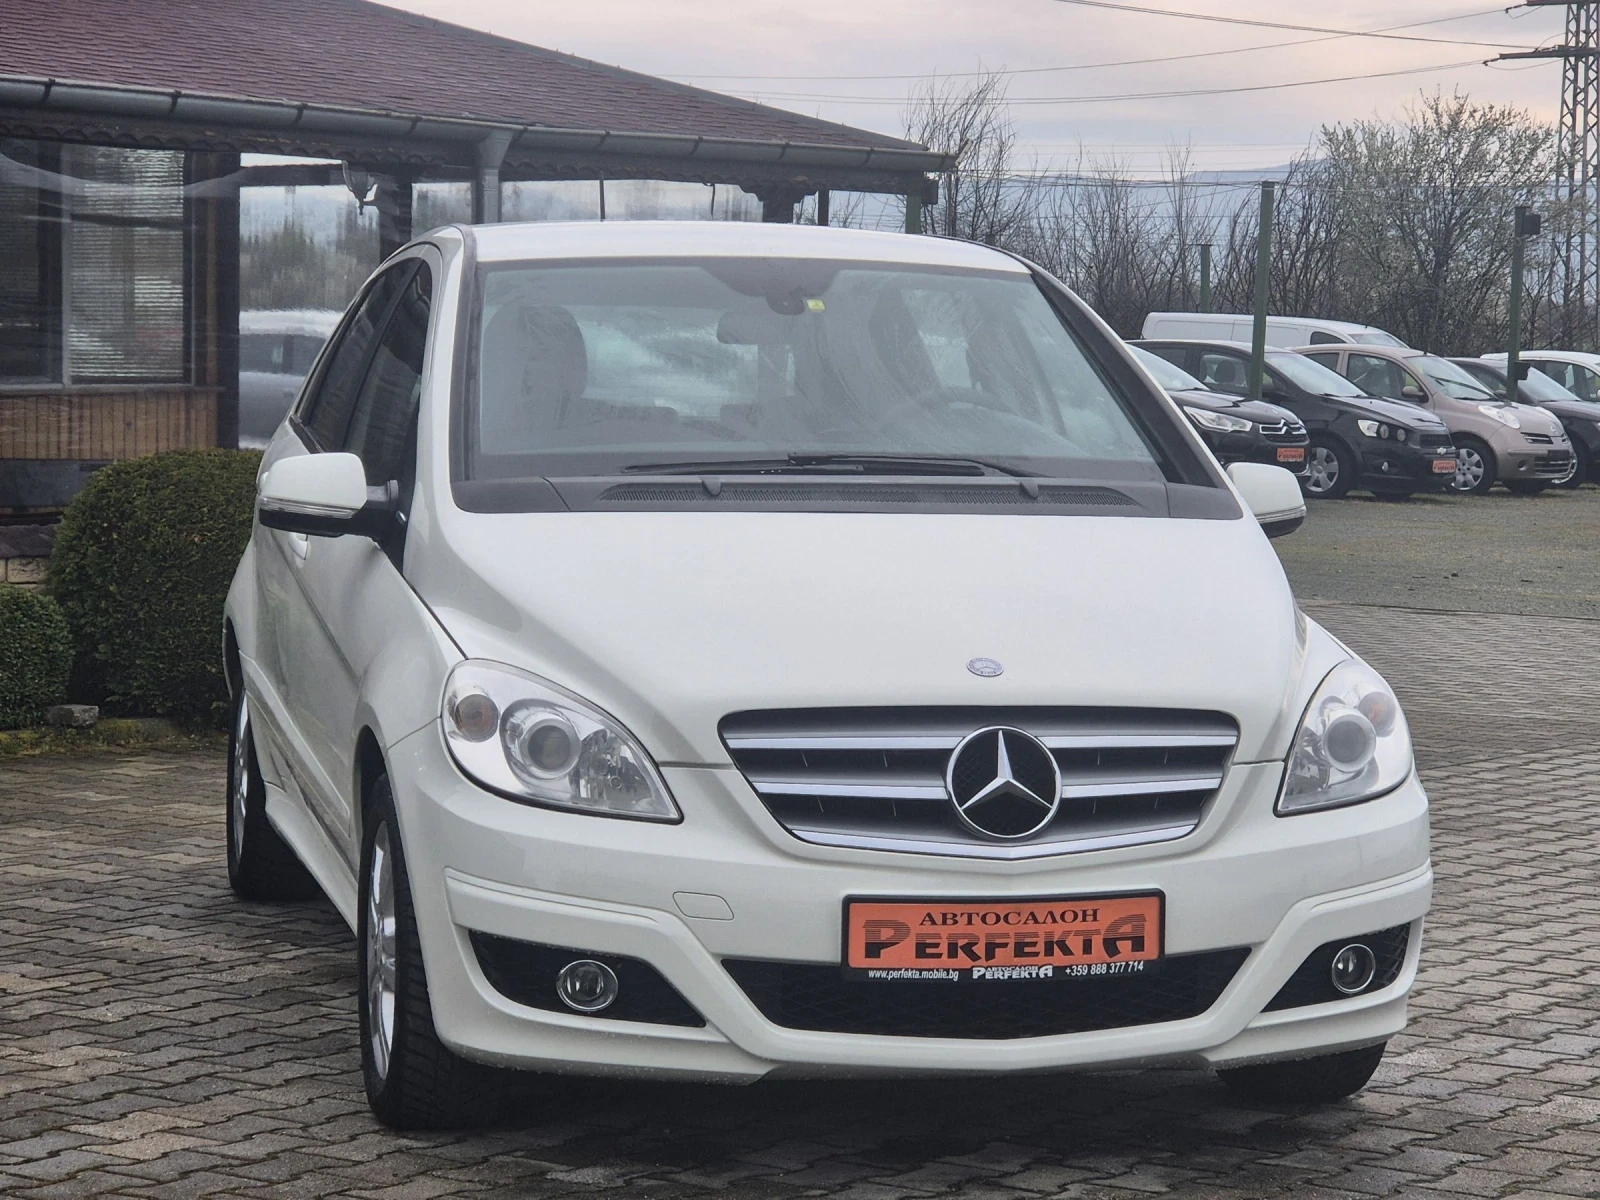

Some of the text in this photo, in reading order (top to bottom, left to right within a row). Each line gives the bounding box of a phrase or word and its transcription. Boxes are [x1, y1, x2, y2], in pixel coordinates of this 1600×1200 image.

[919, 908, 1100, 926] АВТОСАЛОН
[863, 913, 1147, 962] PERFEKTA
[868, 968, 959, 981] www.perfekta.mobile.bg
[972, 965, 1053, 979] PERFEKTA
[1065, 960, 1144, 976] +359 888 377 714
